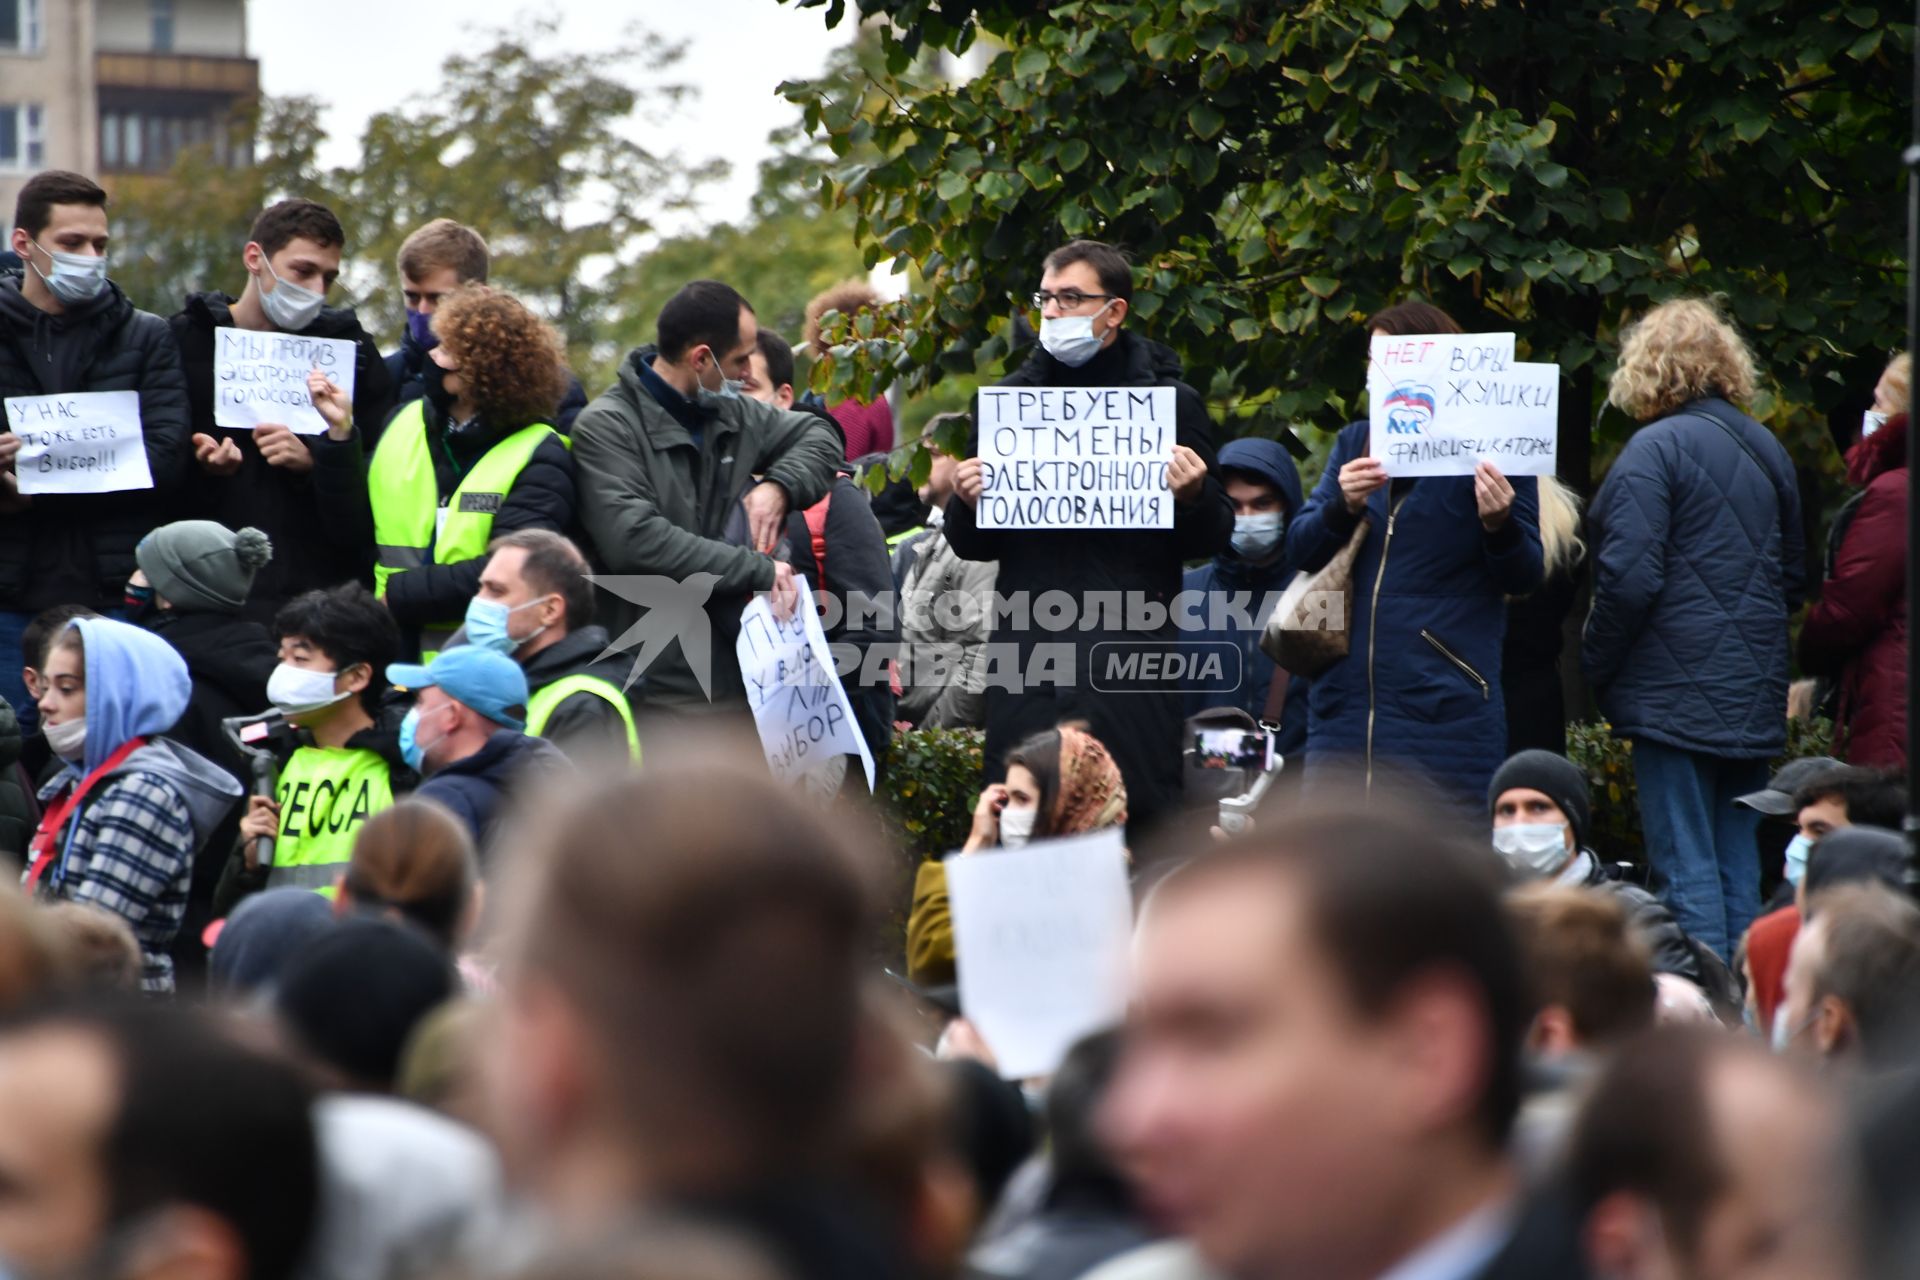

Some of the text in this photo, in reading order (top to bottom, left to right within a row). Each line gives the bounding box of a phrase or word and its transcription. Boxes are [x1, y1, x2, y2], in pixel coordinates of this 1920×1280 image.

[223, 334, 337, 366] МЫ ПРОТИВ
[1384, 341, 1509, 372] НЕТ ВОРЫ
[220, 360, 340, 385] ЭЛЕКТРОННО
[222, 386, 311, 407] ГОЛОСОВА
[984, 390, 1155, 423] ТРЕБУЕМ
[1445, 379, 1553, 408] ЖУЛИКИ
[13, 400, 80, 423] У НАС
[20, 425, 118, 447] ТОЖЕ ЕСТЬ
[994, 426, 1162, 456] ОТМЕНЫ
[982, 461, 1170, 492] ЭЛЕКТРОННОГО
[979, 496, 1161, 526] ГОЛОСОВАНИЯ
